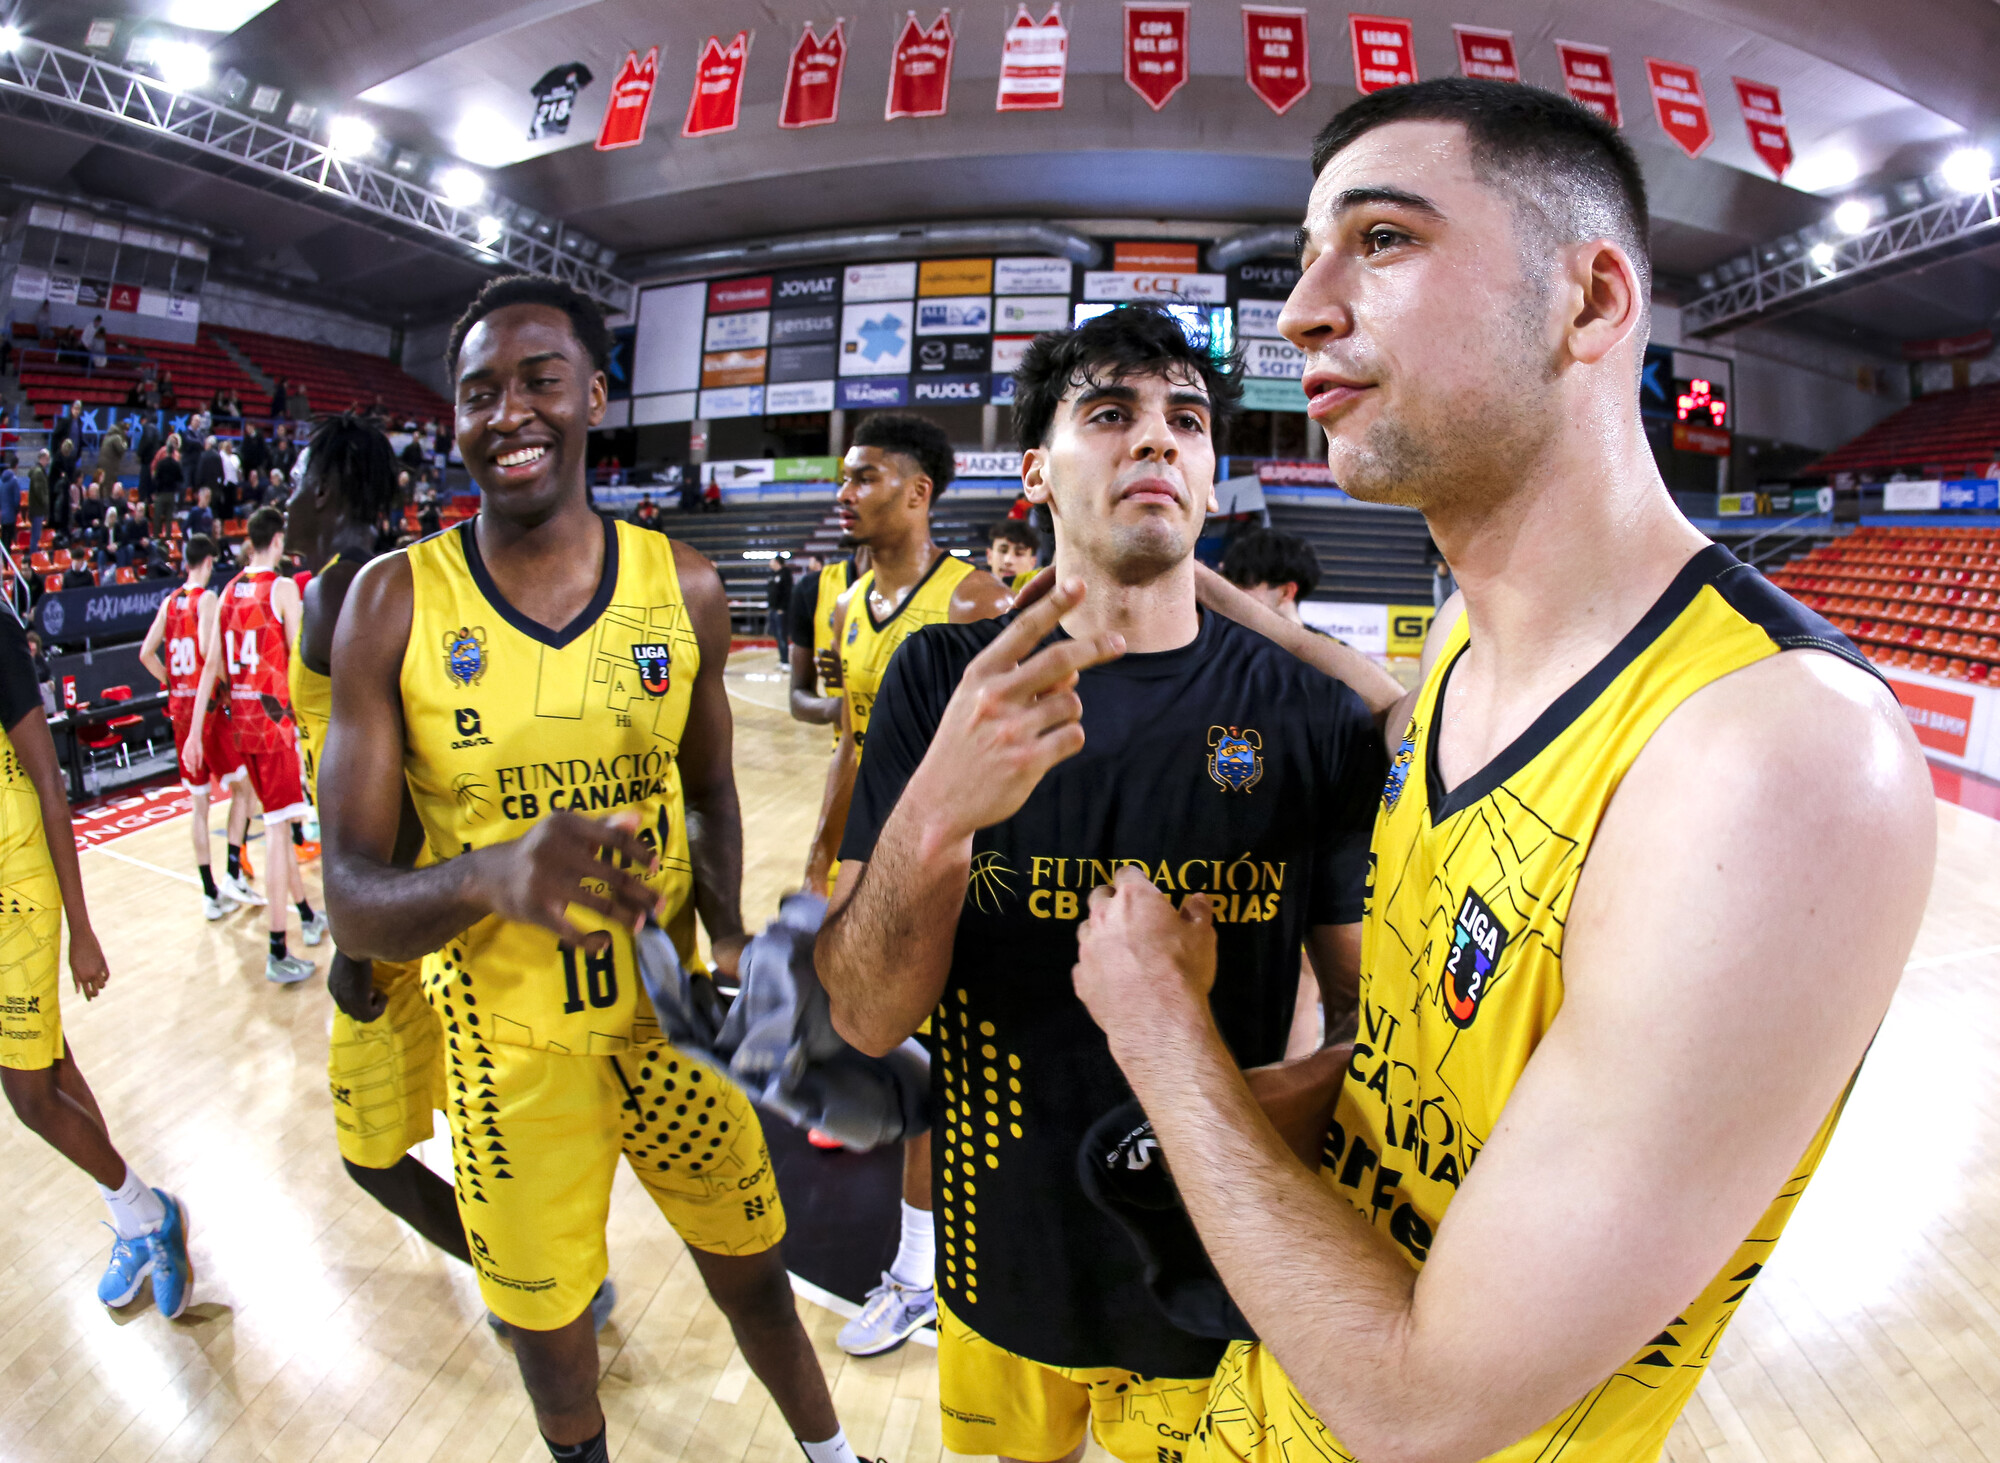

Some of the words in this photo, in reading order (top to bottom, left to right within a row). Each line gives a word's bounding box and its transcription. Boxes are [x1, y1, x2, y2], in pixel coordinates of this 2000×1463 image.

[1139, 21, 1173, 36] COPA
[1258, 25, 1293, 41] LLIGA
[1362, 29, 1403, 47] LLIGA
[1263, 43, 1290, 58] ACB
[778, 277, 836, 298] JOVIAT
[169, 636, 196, 676] 20
[634, 646, 668, 659] LIGA
[641, 667, 651, 679] 2
[659, 666, 668, 679] 2
[615, 681, 626, 692] A
[502, 793, 540, 821] CB
[1028, 889, 1079, 920] CB
[1163, 892, 1281, 923] RIAS
[1459, 896, 1499, 961] LIGA
[1447, 946, 1461, 974] 2
[1468, 971, 1481, 1001] 2
